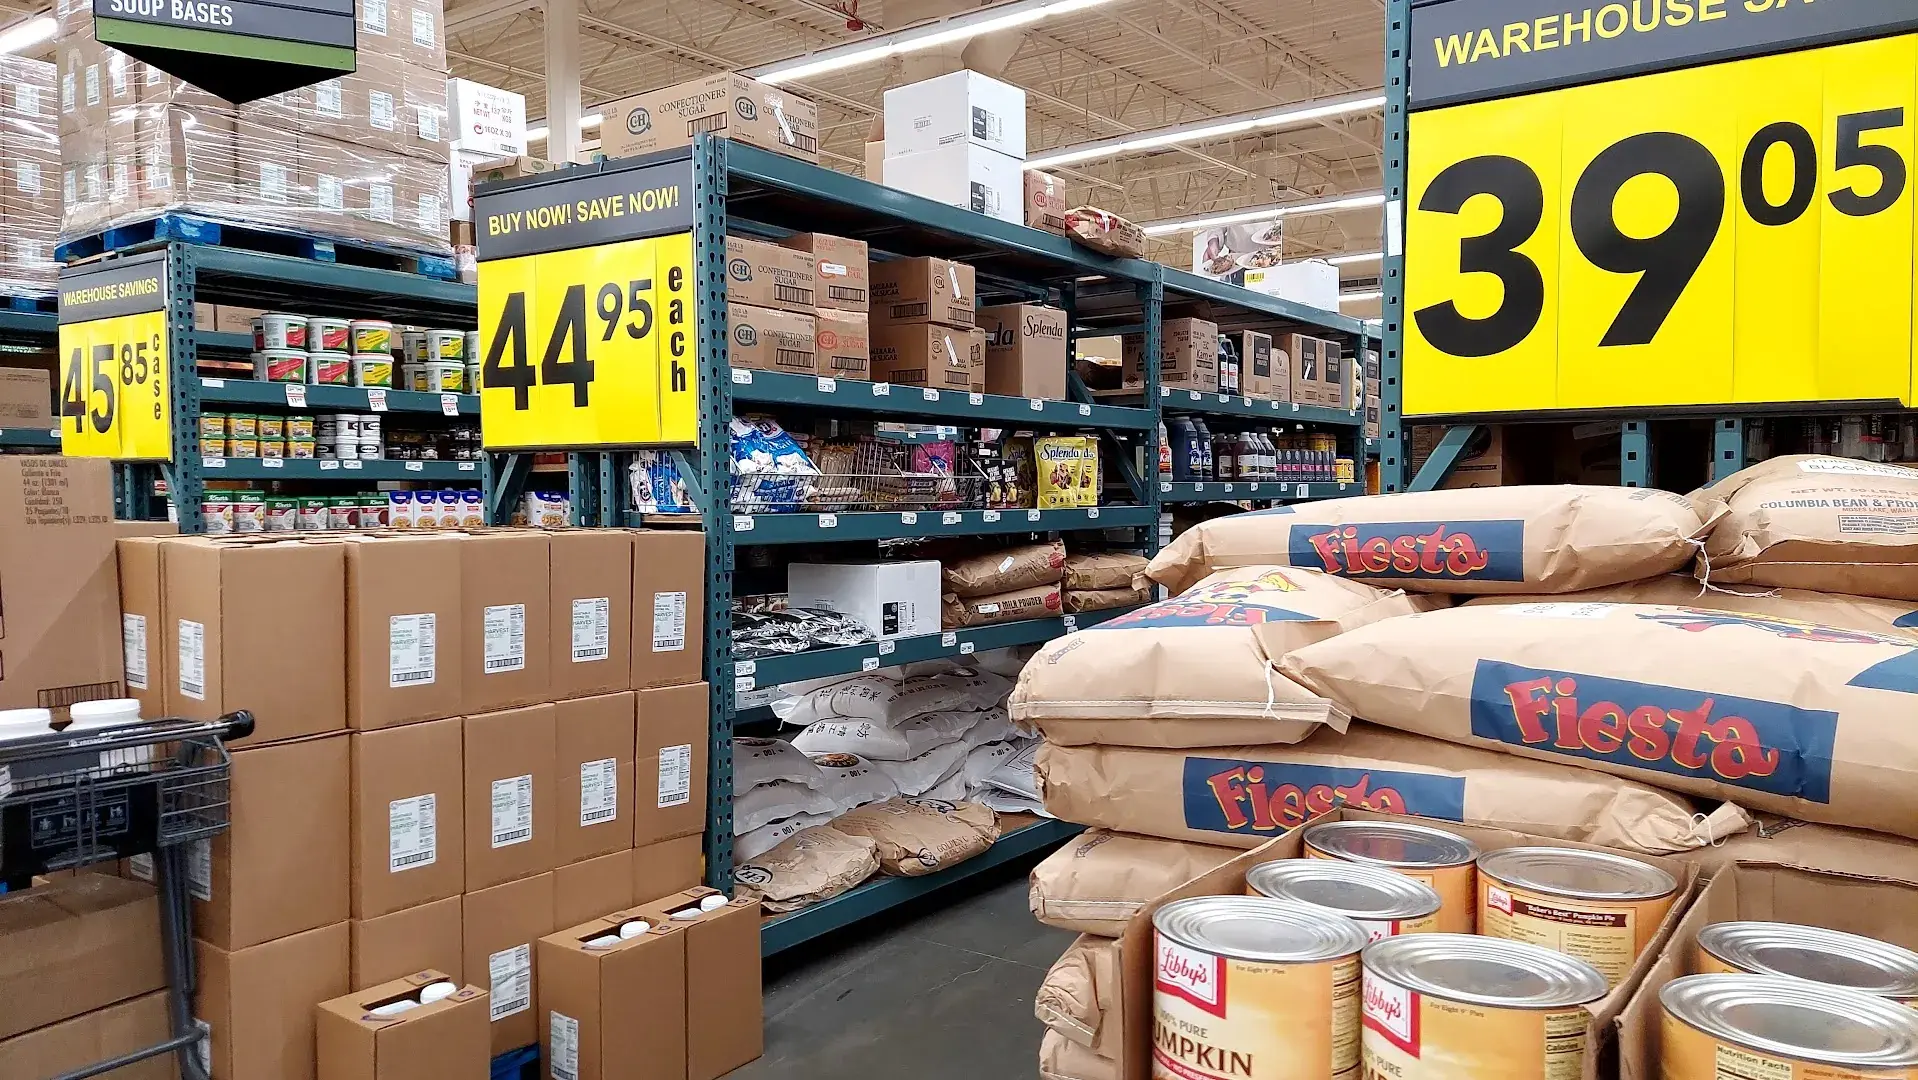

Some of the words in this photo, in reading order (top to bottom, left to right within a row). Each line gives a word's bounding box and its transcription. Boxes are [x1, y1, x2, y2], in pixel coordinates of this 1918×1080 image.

[110, 0, 165, 17] SOUP
[171, 0, 233, 26] BASES
[1434, 0, 1728, 68] WAREHOUSE
[658, 87, 726, 114] CONFECTIONERS
[678, 103, 707, 118] SUGAR
[488, 211, 522, 236] BUY
[526, 203, 573, 230] NOW!
[577, 194, 624, 222] SAVE
[629, 185, 680, 214] NOW!
[1413, 131, 1726, 358] 39
[1740, 106, 1907, 227] 05
[757, 264, 813, 282] CONFECTIONERS
[774, 275, 798, 286] SUGAR
[62, 284, 118, 307] WAREHOUSE
[118, 277, 159, 298] SAVINGS
[667, 265, 687, 393] each
[1023, 315, 1063, 339] Splenda
[483, 283, 596, 411] 44
[596, 278, 654, 342] 95
[778, 339, 801, 348] SUGAR
[61, 343, 115, 434] 45
[121, 341, 148, 386] 85
[152, 333, 161, 420] case
[1040, 443, 1080, 461] Splenda
[1760, 499, 1830, 509] COLUMBIA
[1833, 498, 1868, 508] BEAN
[1872, 498, 1882, 507] &
[1308, 524, 1489, 577] Fiesta
[1018, 596, 1043, 608] POWDER
[1504, 676, 1780, 779] Fiesta
[1573, 911, 1604, 922] Pumpkin
[1160, 947, 1208, 987] Libby's
[1179, 1019, 1208, 1039] PURE
[1153, 1016, 1253, 1079] UMPKIN
[1716, 1045, 1758, 1064] Nutrition
[1761, 1058, 1791, 1073] Facts
[1376, 1055, 1403, 1079] PURE
